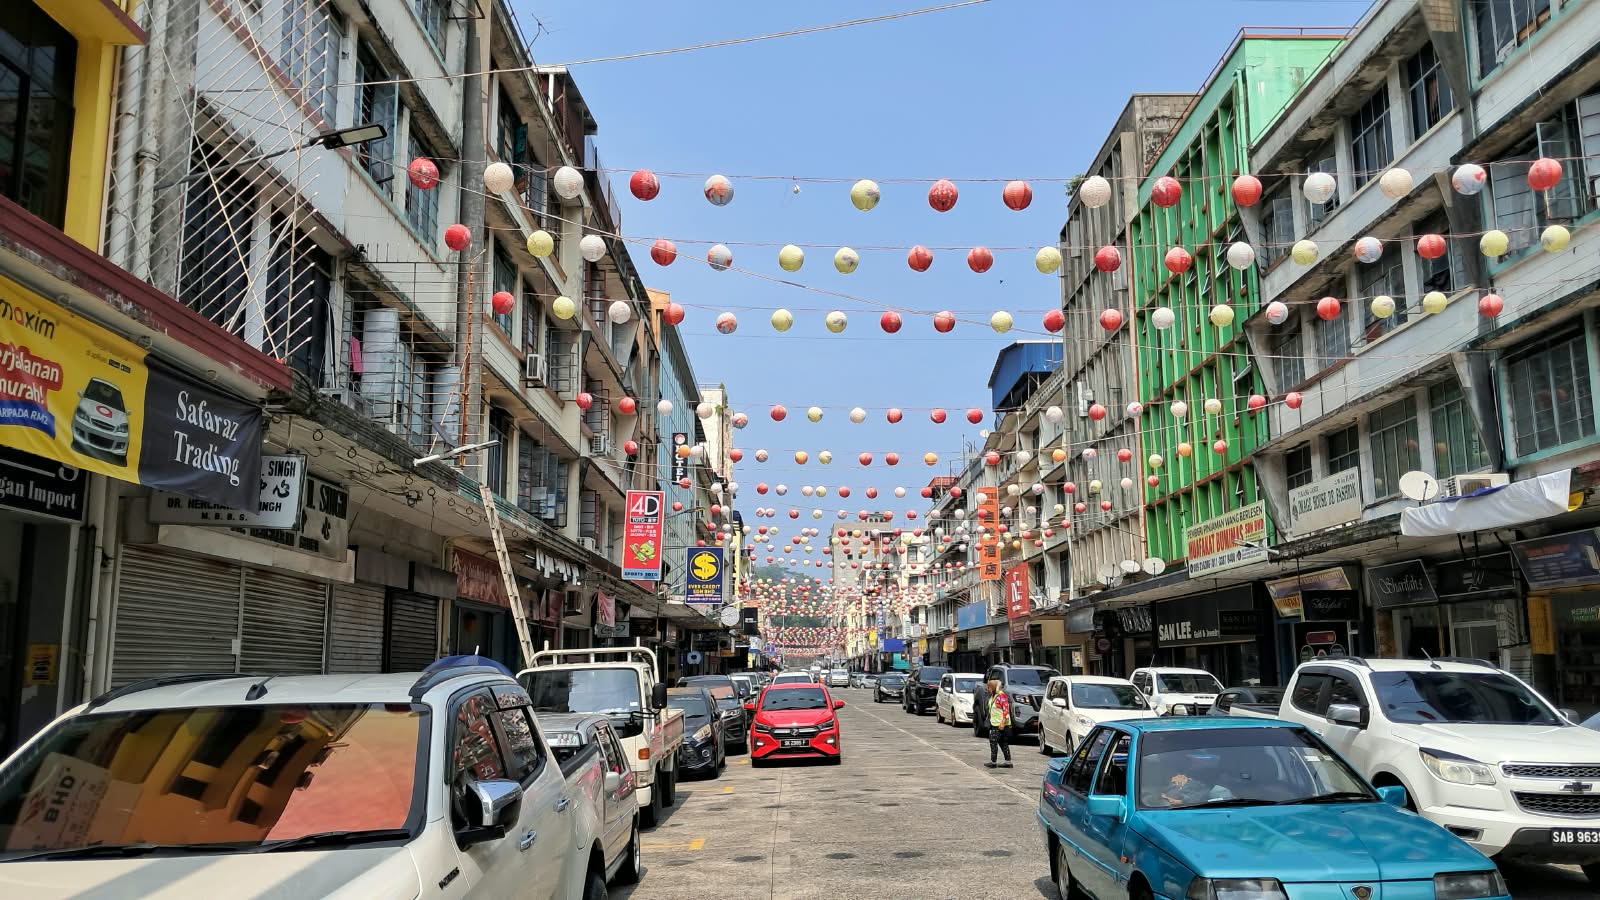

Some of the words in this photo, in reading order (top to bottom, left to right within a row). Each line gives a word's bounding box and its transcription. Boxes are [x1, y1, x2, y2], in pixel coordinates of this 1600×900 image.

[0, 346, 60, 383] rjalanan
[176, 390, 240, 442] Safaraz
[173, 430, 240, 486] Trading
[268, 460, 297, 478] SINGH
[28, 480, 77, 510] Import
[631, 495, 660, 516] 4D
[258, 501, 282, 513] INGH
[1158, 623, 1176, 641] SAN
[1175, 621, 1192, 640] LEE
[1552, 831, 1574, 843] SAB
